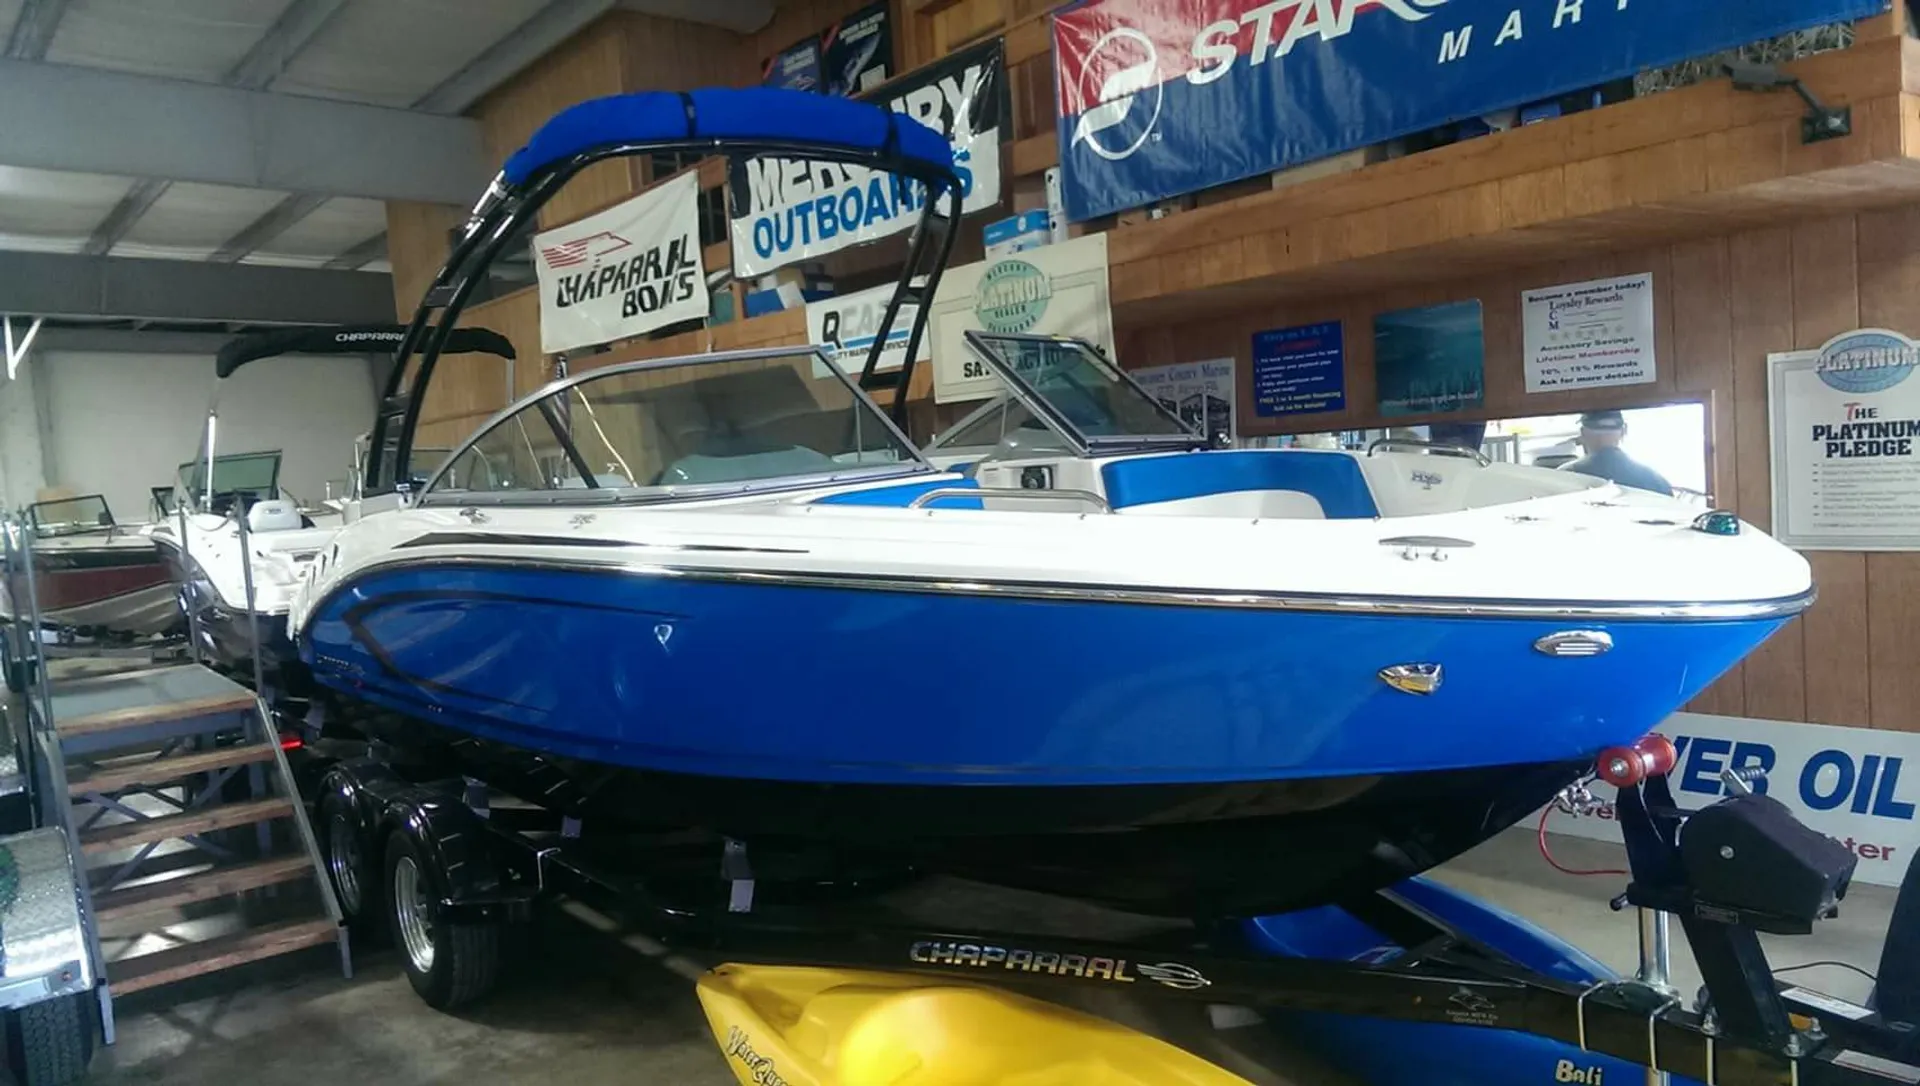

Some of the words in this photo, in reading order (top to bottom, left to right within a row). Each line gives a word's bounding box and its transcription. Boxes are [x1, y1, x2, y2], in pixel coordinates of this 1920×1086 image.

[1529, 293, 1563, 303] Become
[1574, 285, 1613, 295] member
[1615, 280, 1646, 290] today!
[1549, 299, 1583, 311] Loyalty
[1585, 293, 1623, 305] Rewards
[1548, 321, 1559, 330] M
[1536, 353, 1576, 363] Lifetime
[1579, 346, 1640, 358] Membership
[1540, 340, 1592, 352] Accessory
[1594, 337, 1635, 346] Savings
[1593, 361, 1638, 370] Rewards
[1814, 346, 1920, 373] PLATINUM
[1560, 376, 1574, 384] for
[1604, 370, 1644, 380] details!
[1843, 401, 1879, 421] THE
[1812, 420, 1920, 441] PLATINUM
[1825, 438, 1912, 458] PLEDGE
[1798, 749, 1916, 820] OIL
[909, 941, 1136, 983] CHAPARRAL
